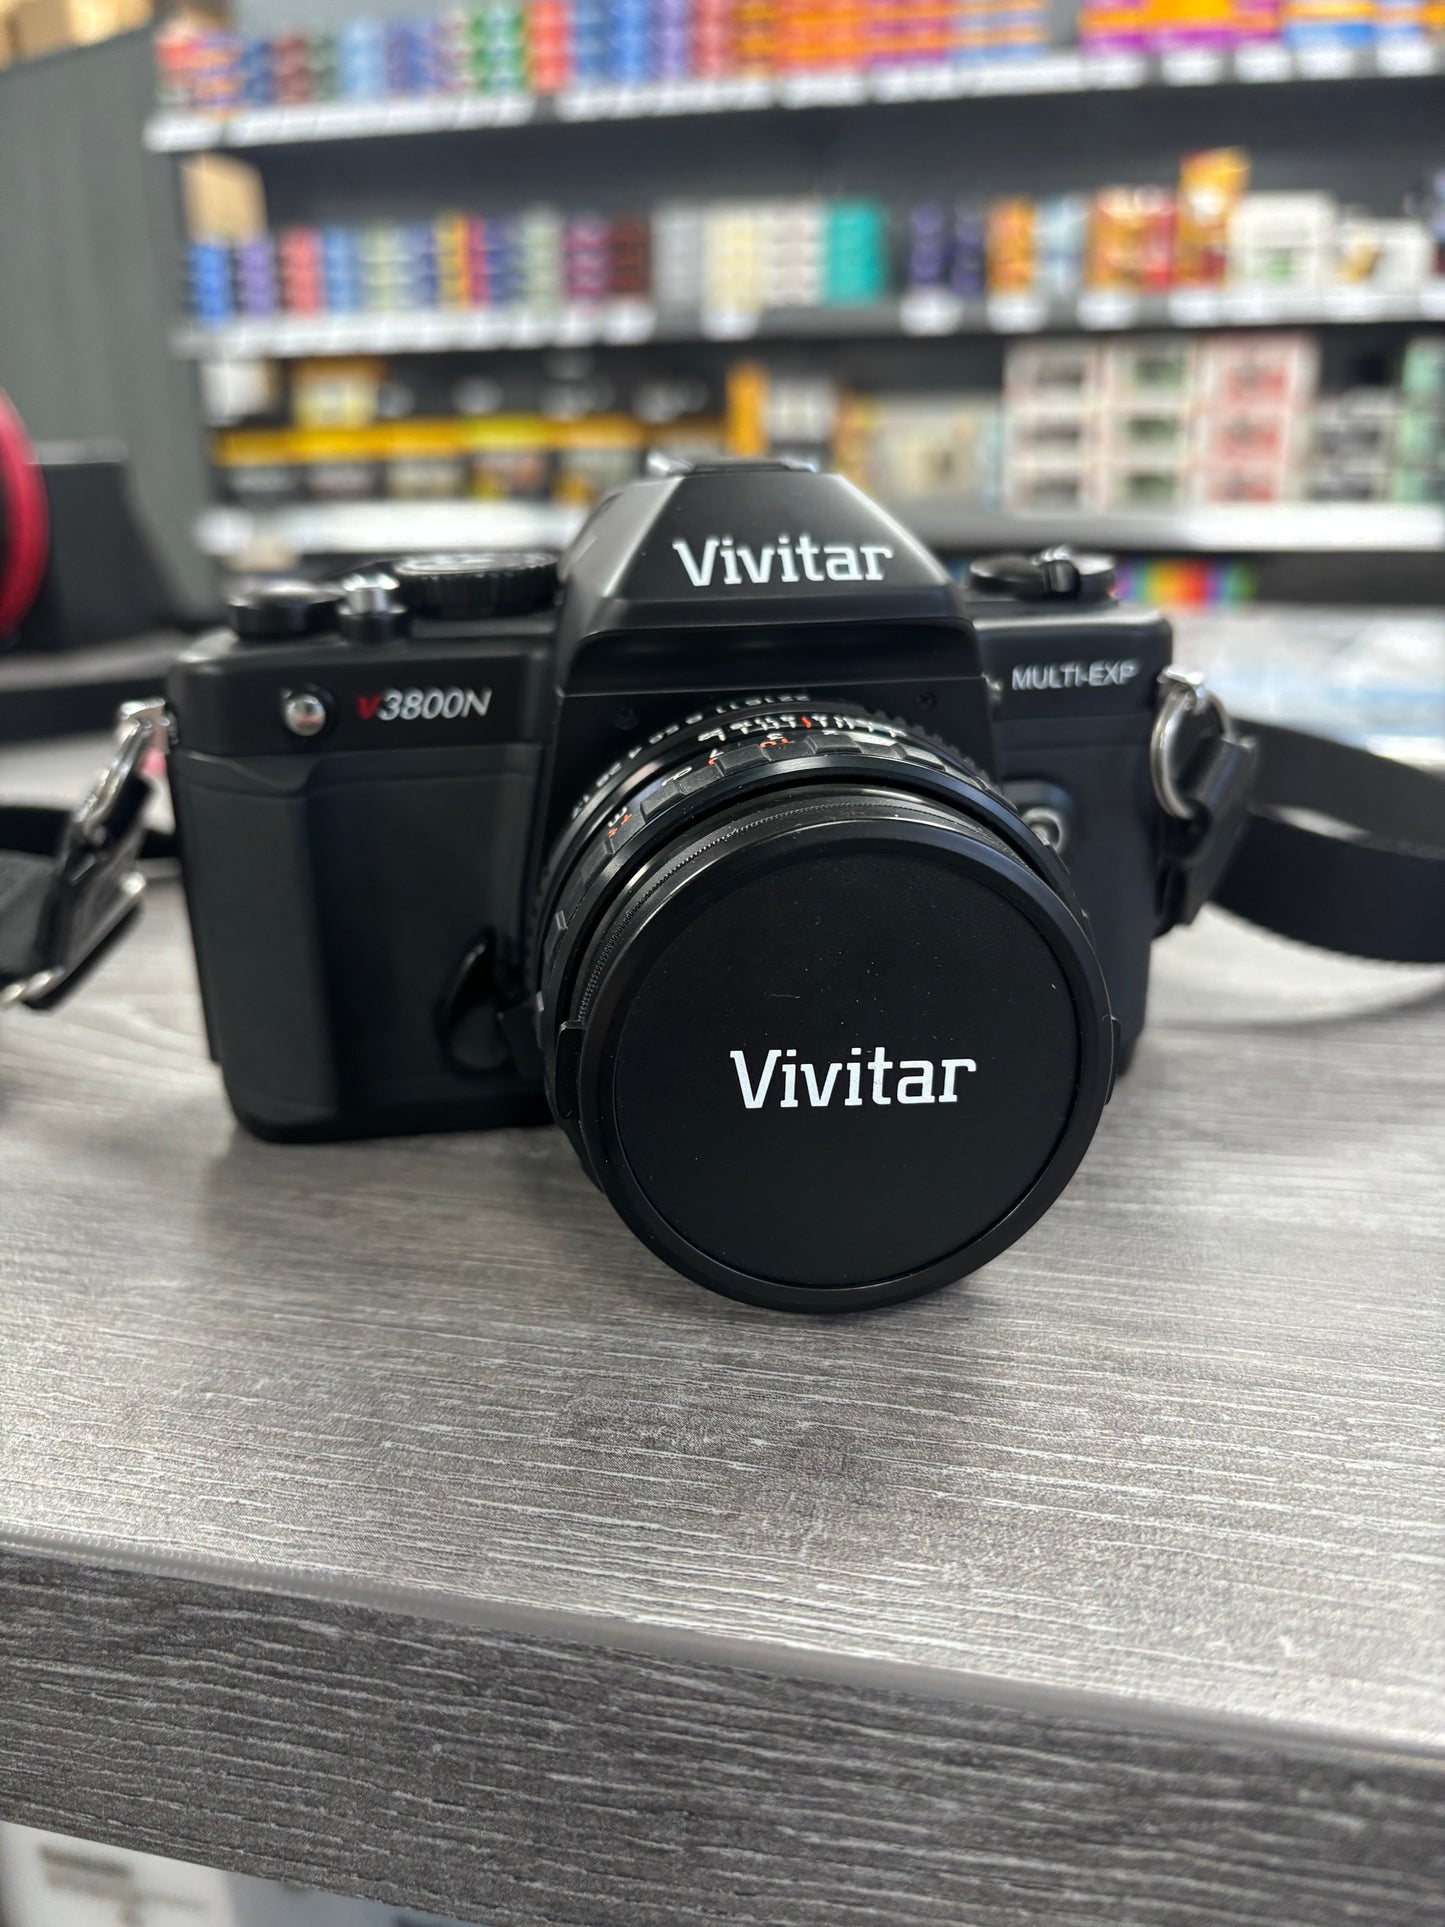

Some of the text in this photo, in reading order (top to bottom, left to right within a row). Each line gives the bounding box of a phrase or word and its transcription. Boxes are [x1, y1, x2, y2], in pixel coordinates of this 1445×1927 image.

[672, 534, 894, 587] Vivitar
[1011, 659, 1139, 691] MULTI-EXP
[730, 1046, 976, 1109] Vivitar
